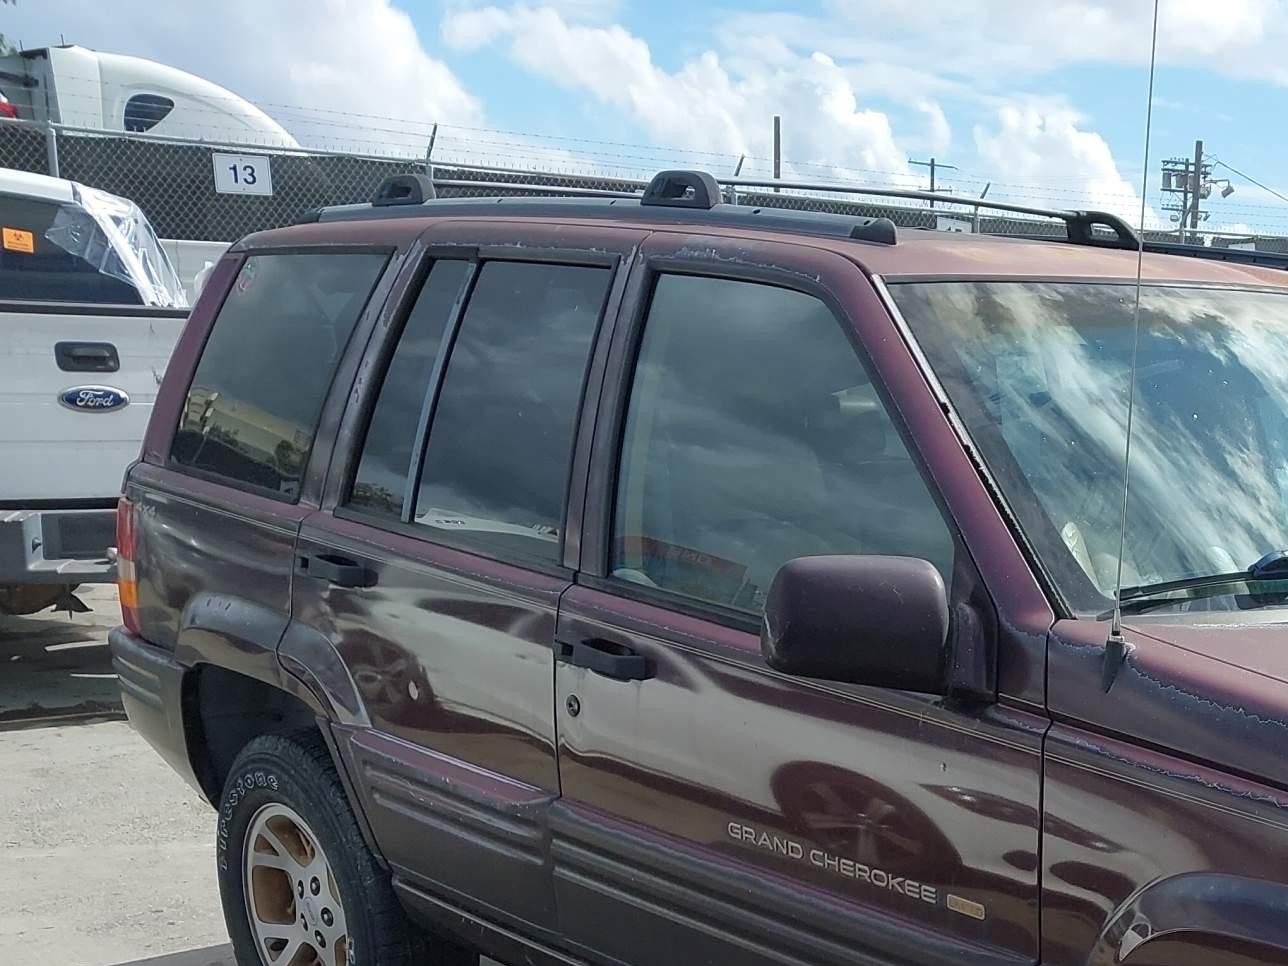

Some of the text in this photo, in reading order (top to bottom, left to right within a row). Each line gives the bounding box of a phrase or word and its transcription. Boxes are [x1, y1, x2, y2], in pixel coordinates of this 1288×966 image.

[229, 164, 257, 185] 13
[76, 390, 114, 406] Ford
[727, 822, 937, 904] GRAND CHEROKEE
